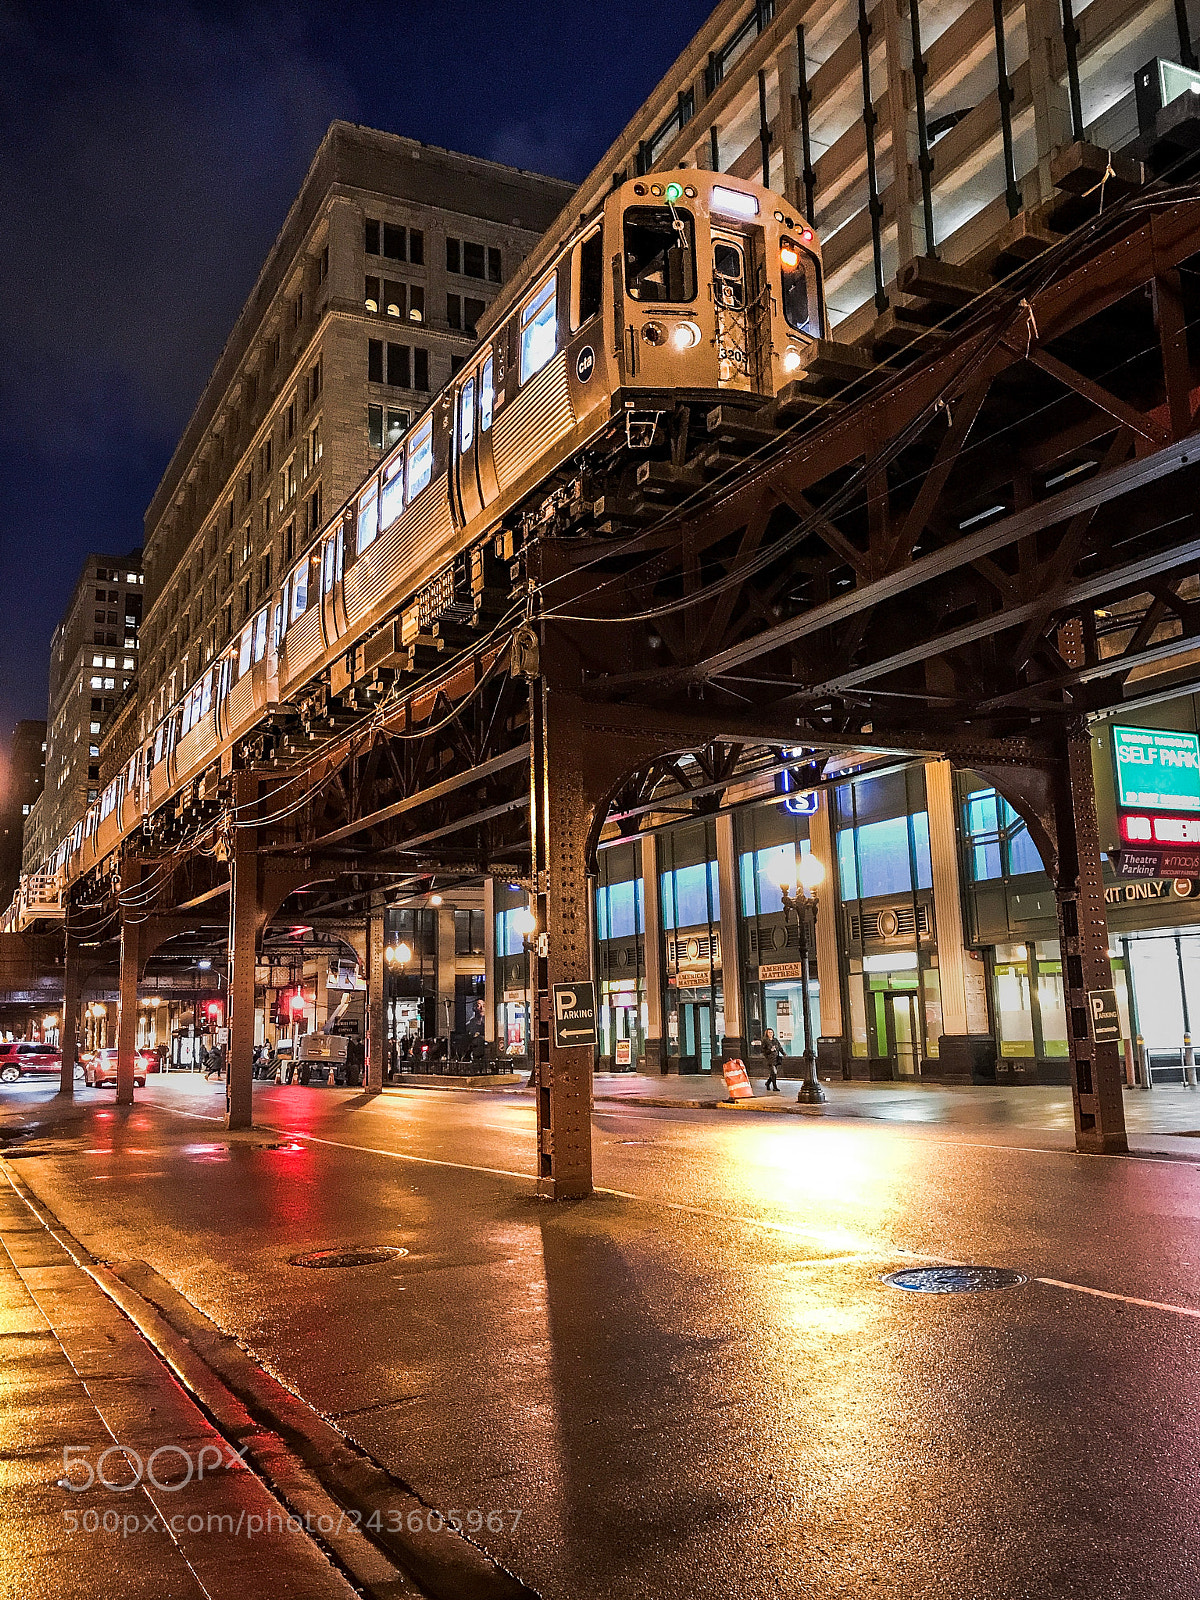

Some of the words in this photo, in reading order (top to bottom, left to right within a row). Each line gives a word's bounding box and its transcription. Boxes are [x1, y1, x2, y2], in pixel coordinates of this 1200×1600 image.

[1119, 745, 1158, 765] SELF
[1160, 749, 1200, 769] PARK
[1124, 854, 1158, 865] Theatre
[1122, 864, 1155, 877] Parking
[1125, 881, 1164, 900] ONLY
[761, 963, 800, 973] AMERICAN
[761, 970, 800, 978] MATTRESS
